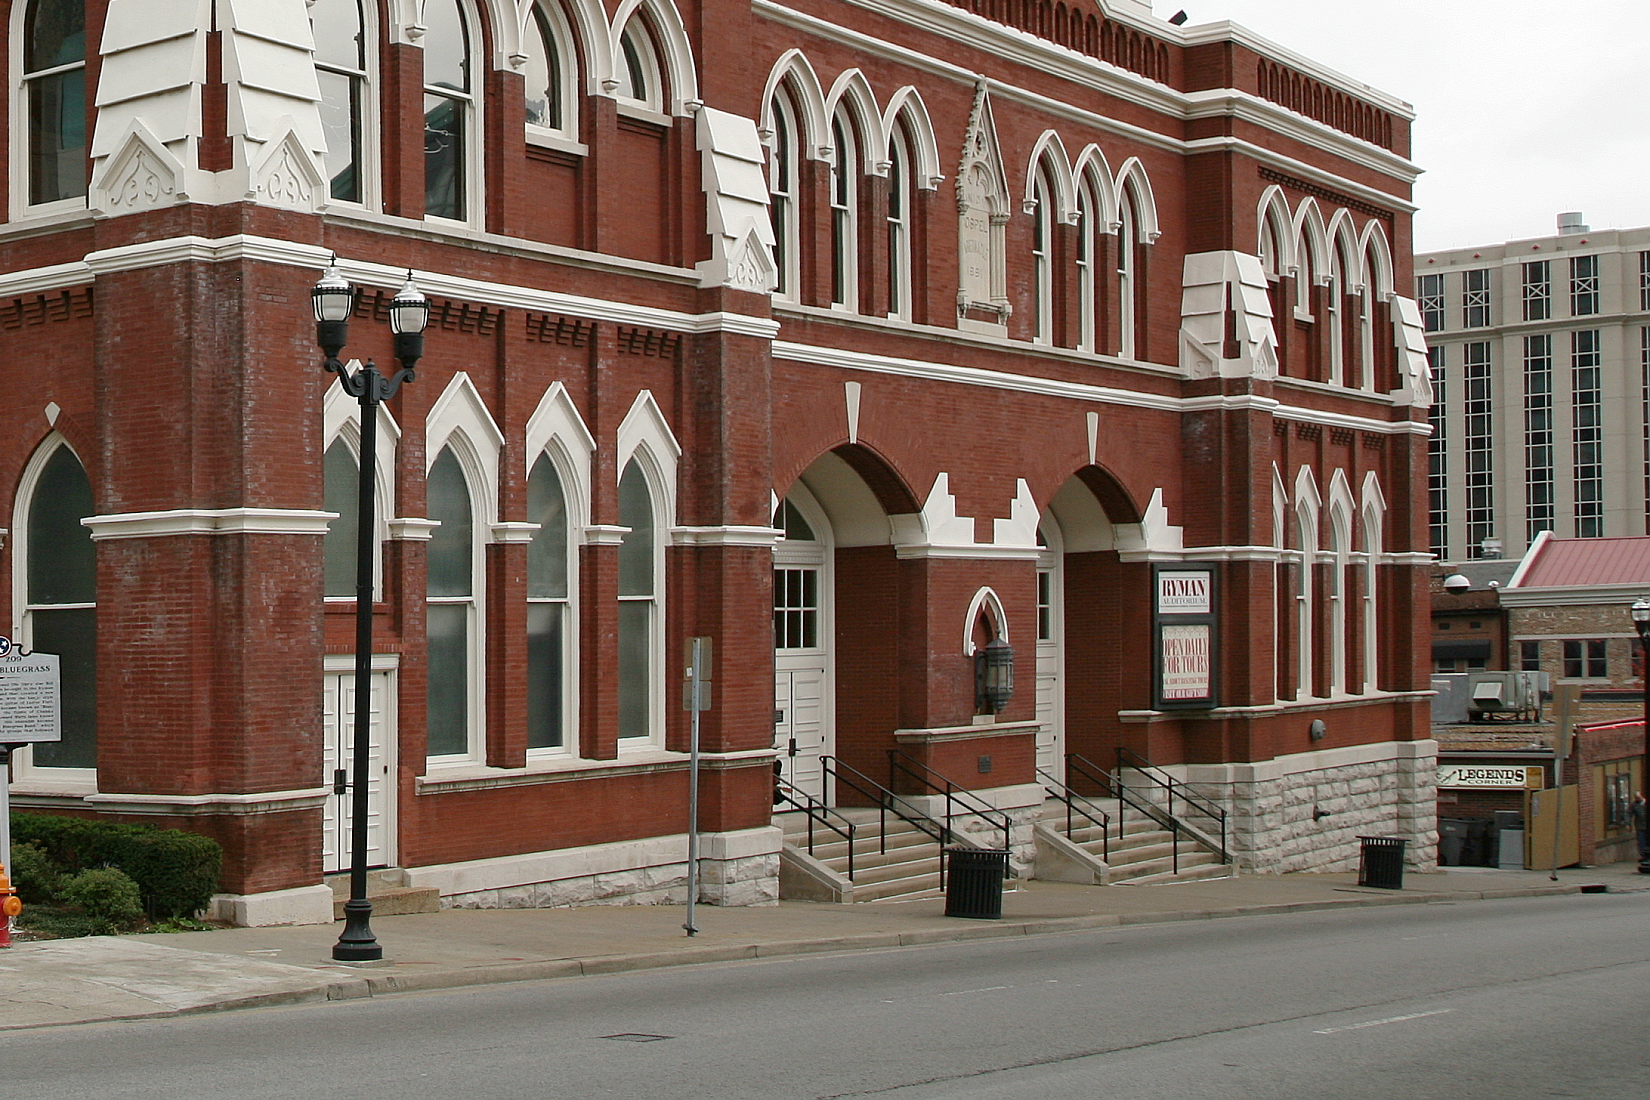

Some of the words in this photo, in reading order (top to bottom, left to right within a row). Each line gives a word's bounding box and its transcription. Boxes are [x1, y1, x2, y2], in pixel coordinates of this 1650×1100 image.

[1162, 579, 1206, 597] RYMAN
[1185, 637, 1208, 656] DAILY
[5, 655, 22, 663] 209
[0, 665, 51, 674] BLUEGRASS
[1457, 769, 1524, 782] LEGENDS
